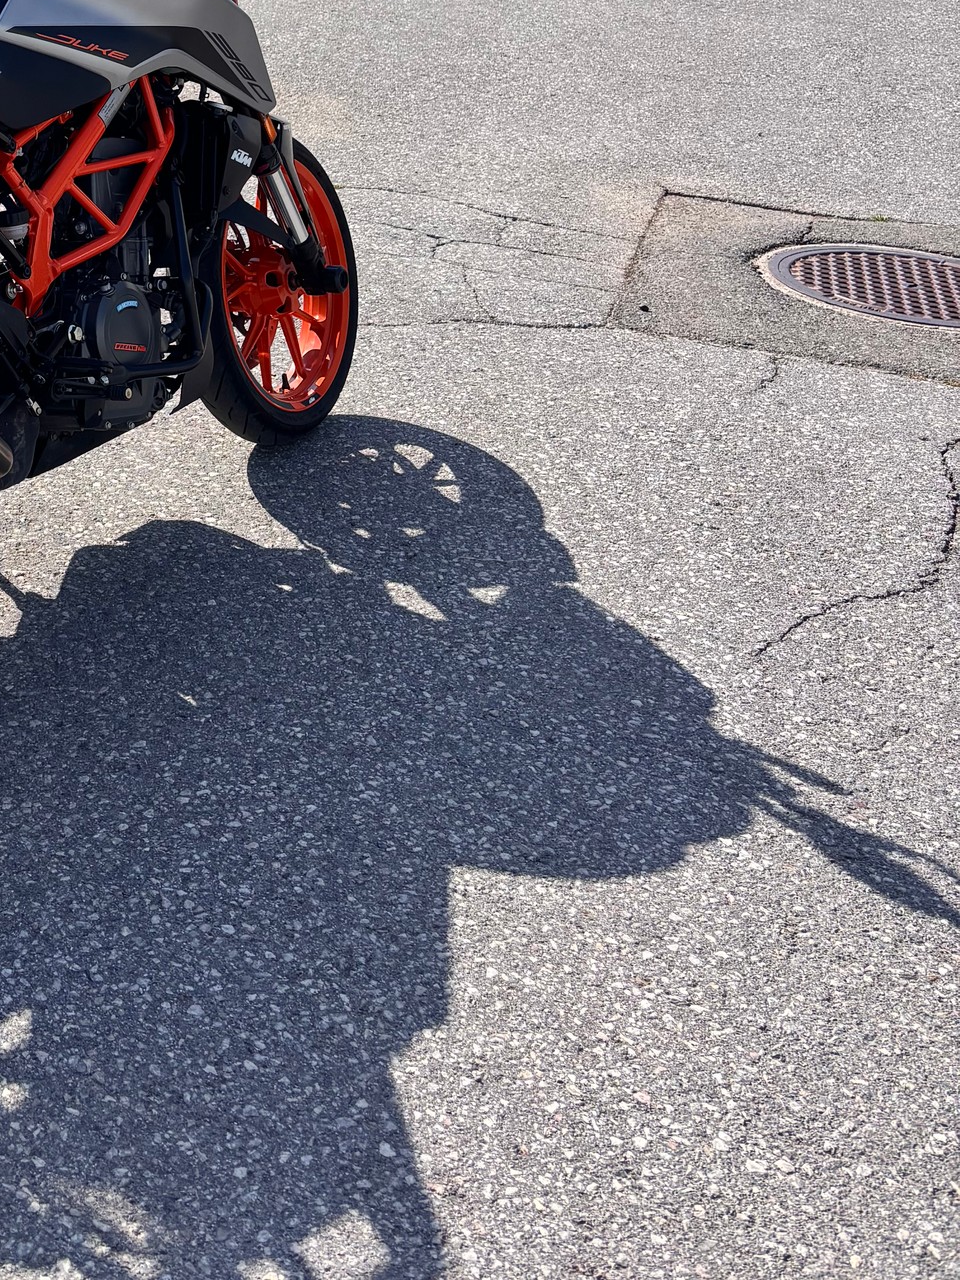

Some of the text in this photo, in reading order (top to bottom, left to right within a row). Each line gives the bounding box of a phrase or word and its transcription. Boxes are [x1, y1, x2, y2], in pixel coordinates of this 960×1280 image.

[35, 33, 129, 60] DUKE
[204, 30, 272, 102] 390
[231, 149, 252, 168] KTM
